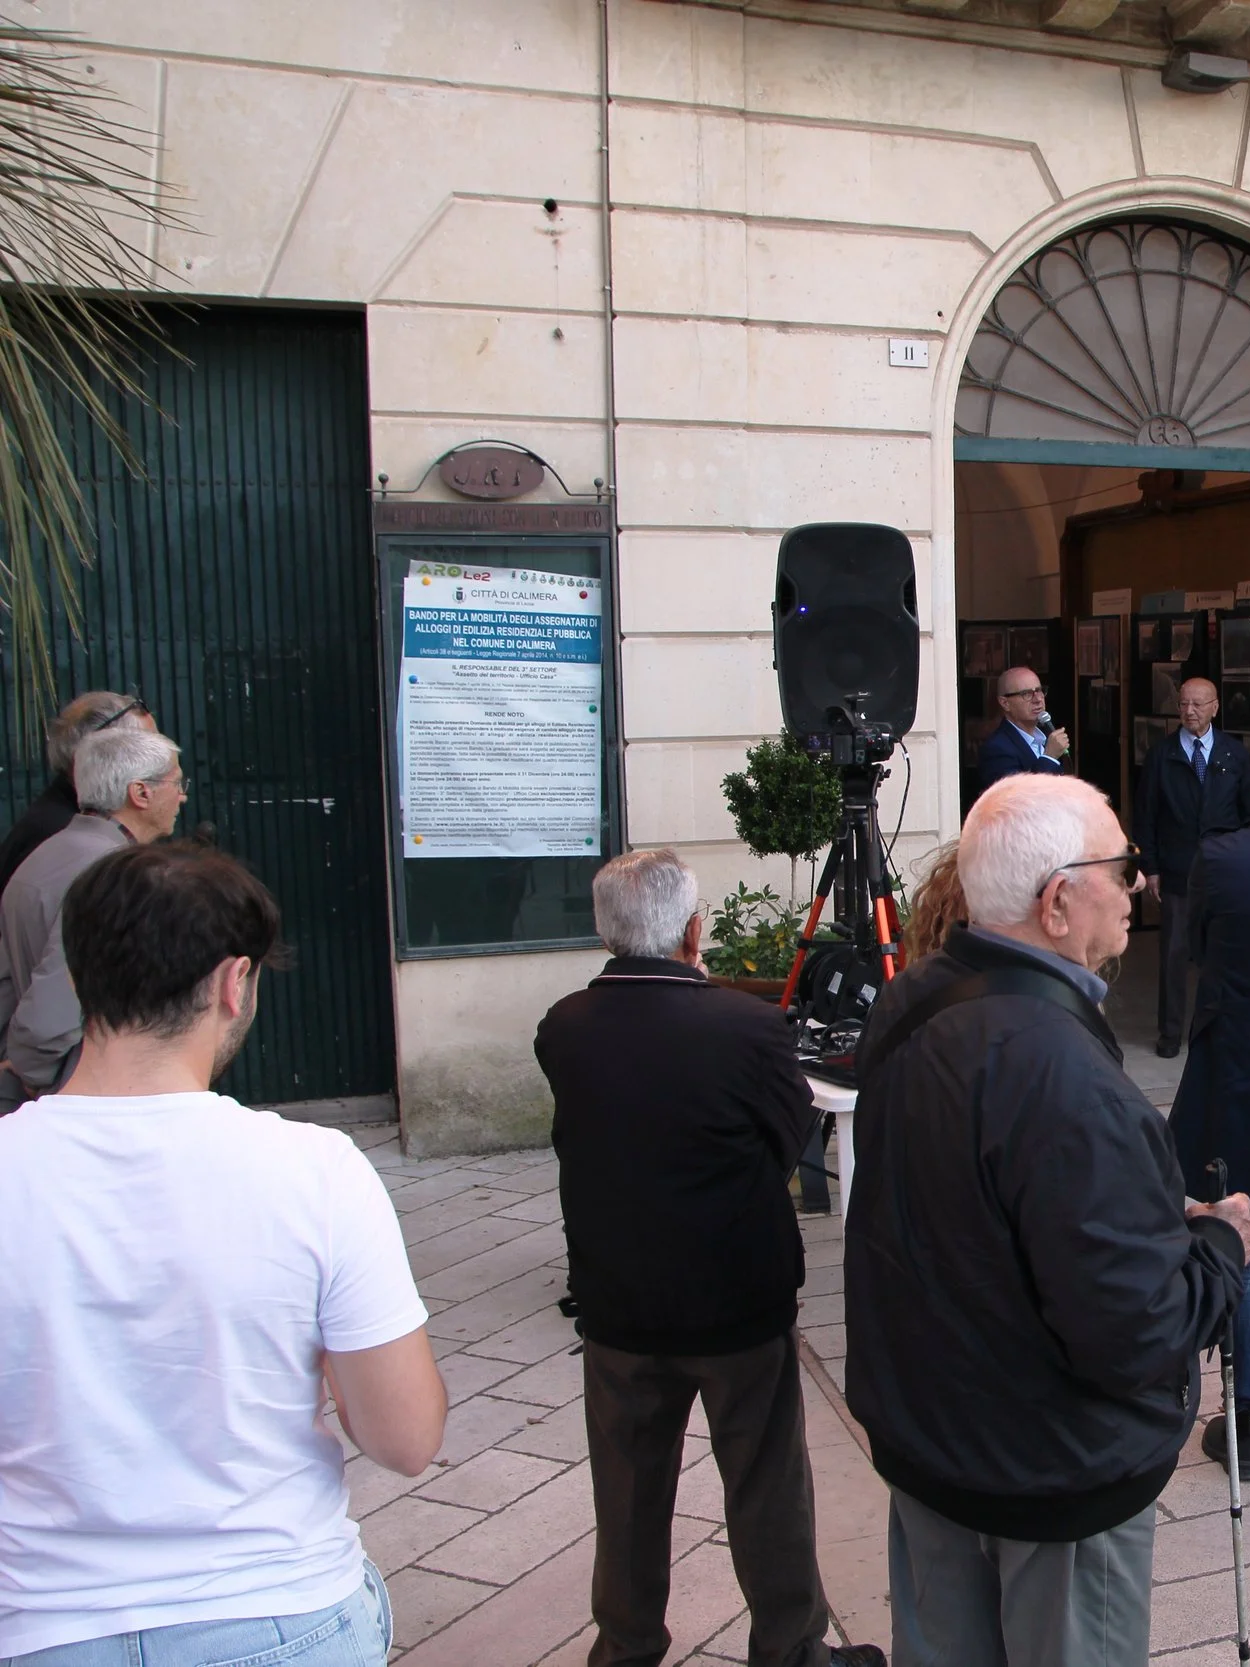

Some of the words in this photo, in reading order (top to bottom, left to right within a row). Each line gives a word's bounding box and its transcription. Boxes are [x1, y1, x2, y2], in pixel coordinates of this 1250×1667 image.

[904, 346, 914, 361] 11
[416, 563, 462, 578] ARO
[463, 570, 492, 582] Le2
[470, 587, 498, 599] CITTÀ
[500, 590, 511, 599] DI
[512, 591, 558, 602] CALIMERA
[408, 610, 439, 621] BANDO
[440, 611, 457, 621] PER
[458, 612, 469, 622] LA
[470, 612, 508, 624] MOBILITÀ
[509, 614, 533, 625] DEGLI
[534, 615, 588, 627] ASSEGNATARI
[589, 618, 598, 627] DI
[414, 623, 451, 634] ALLOGGI
[452, 625, 461, 634] DI
[462, 625, 496, 636] EDILIZIA
[496, 626, 553, 638] RESIDENZIALE
[553, 629, 592, 640] PUBBLICA
[452, 637, 469, 647] NEL
[470, 638, 505, 649] COMUNE
[506, 639, 515, 649] DI
[516, 640, 557, 650] CALIMERA
[459, 664, 507, 672] RESPONSABILE
